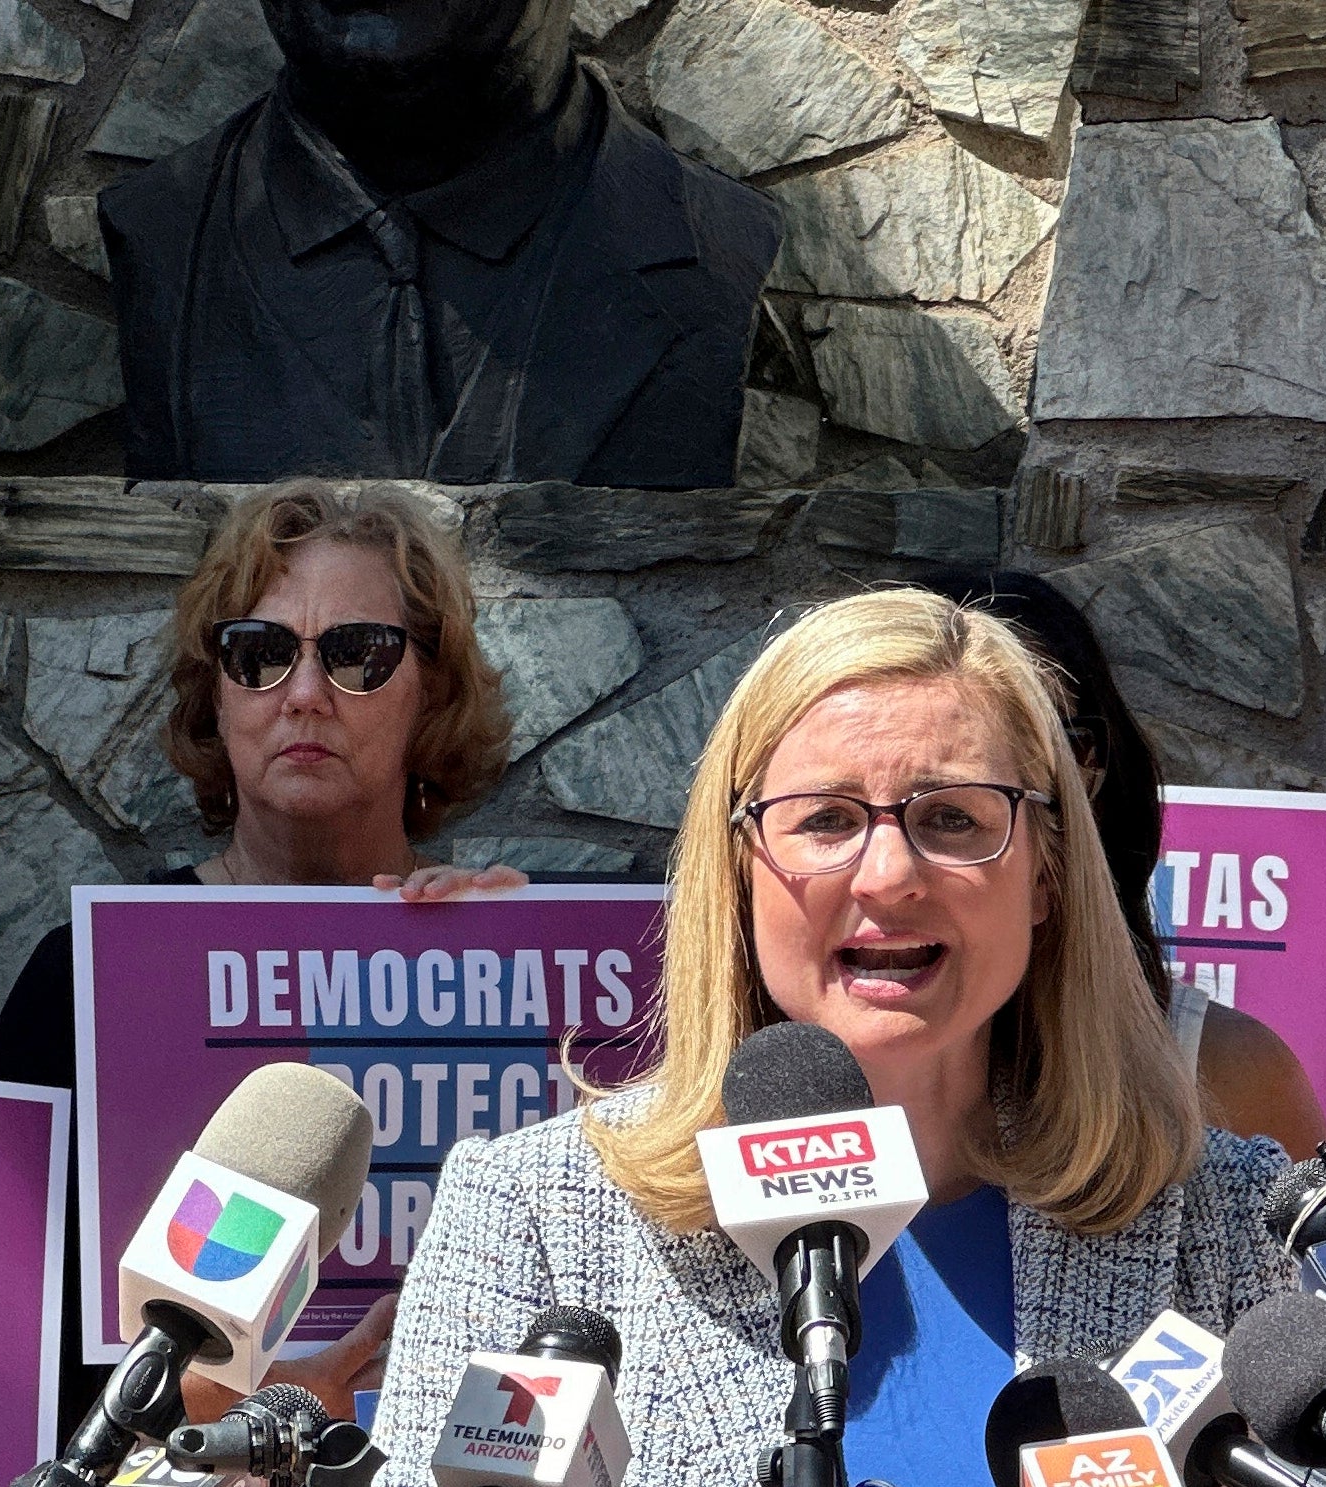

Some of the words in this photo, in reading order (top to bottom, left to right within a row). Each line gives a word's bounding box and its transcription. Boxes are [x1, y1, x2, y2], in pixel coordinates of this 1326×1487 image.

[1147, 851, 1289, 932] TAS
[207, 948, 634, 1028] DEMOCRATS
[315, 1063, 585, 1147] OTECT
[749, 1131, 866, 1170] KTAR
[760, 1166, 874, 1198] NEWS
[818, 1192, 852, 1204] 92.3
[855, 1188, 877, 1200] FM
[453, 1424, 566, 1449] TELEMUNDO
[463, 1443, 539, 1463] ARIZONA
[1069, 1448, 1137, 1479] AZ
